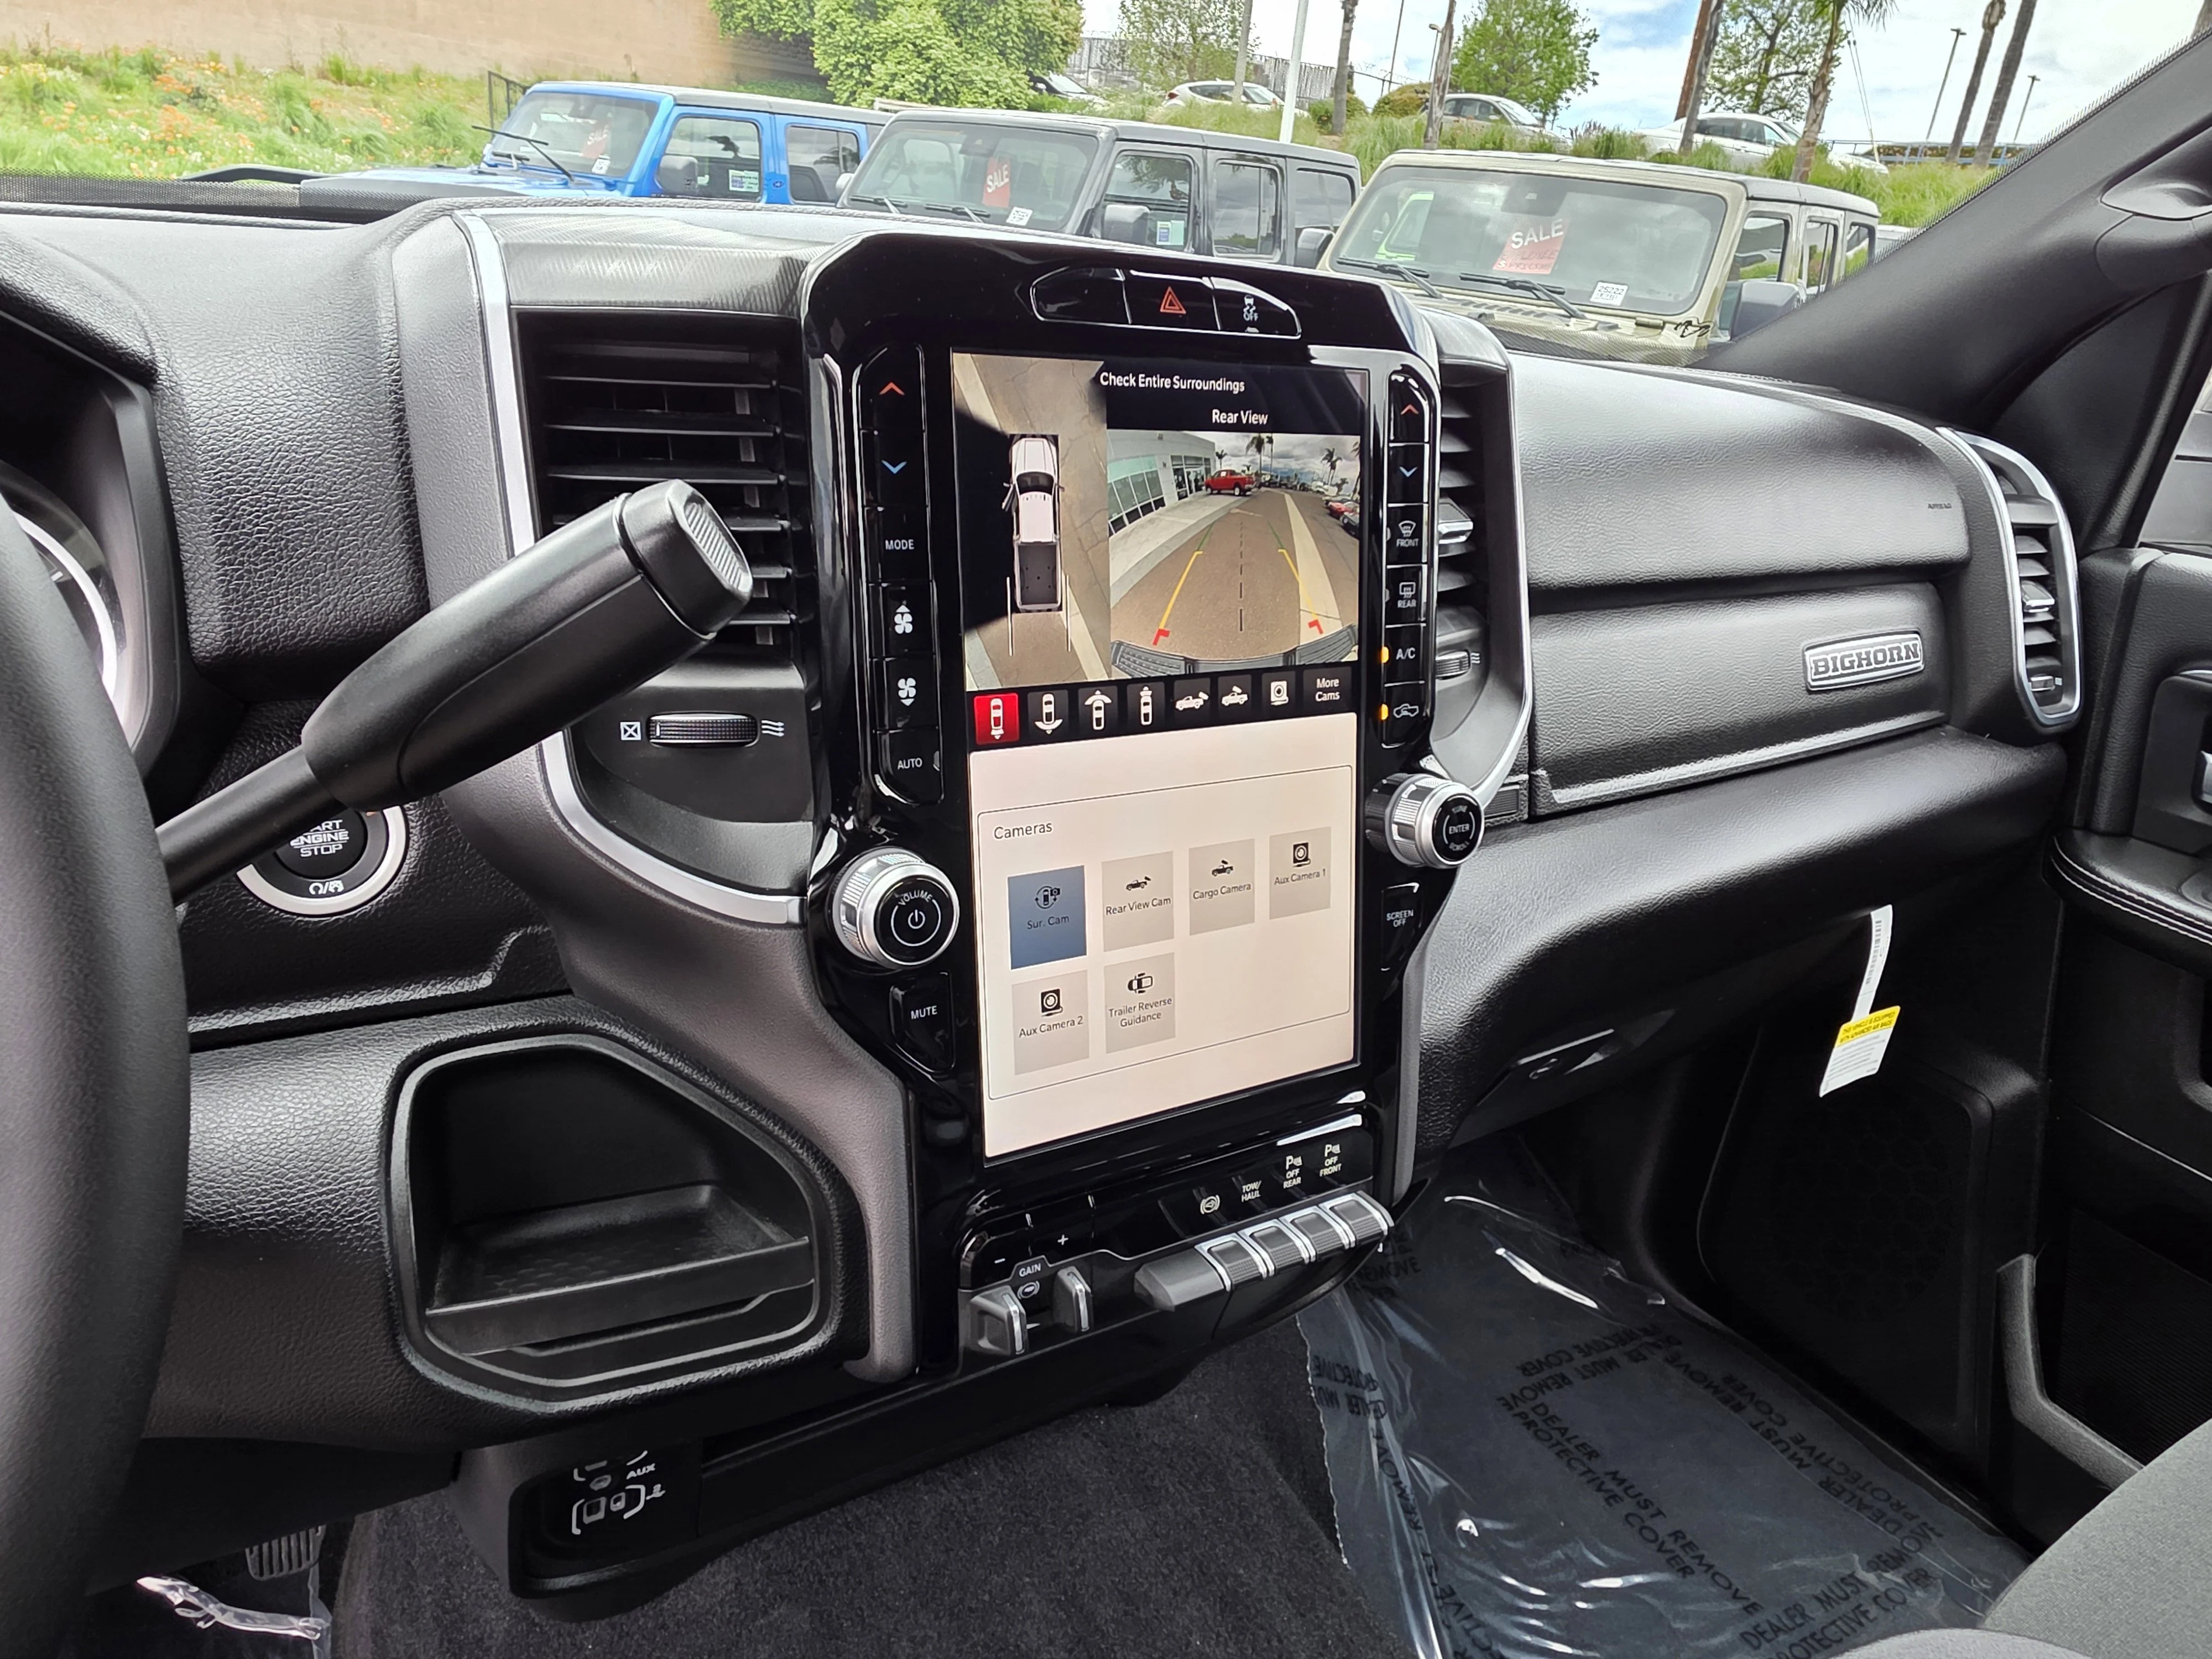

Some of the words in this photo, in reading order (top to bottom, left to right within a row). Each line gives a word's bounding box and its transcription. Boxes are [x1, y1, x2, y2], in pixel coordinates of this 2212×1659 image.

[987, 164, 1009, 193] SALE
[1511, 218, 1564, 249] SALE
[1243, 312, 1259, 321] OFF
[1099, 372, 1136, 387] Check
[1138, 373, 1171, 389] Entire
[1173, 375, 1245, 394] Surroundings
[1212, 409, 1239, 424] Rear
[1240, 410, 1269, 425] View
[885, 539, 915, 550] MODE
[1396, 538, 1419, 547] FRONT
[1397, 599, 1417, 608] REAR
[1396, 648, 1416, 660] A/C
[1811, 641, 1921, 679] BIGHORN
[1316, 677, 1339, 688] More
[1315, 691, 1340, 702] Cams
[897, 757, 923, 770] AUTO
[994, 822, 1052, 839] Cameras
[1449, 823, 1470, 834] ENTER
[290, 831, 349, 847] ENGINE
[300, 843, 343, 858] STOP
[1274, 875, 1290, 885] Aux
[1291, 870, 1320, 883] Camera
[1322, 868, 1326, 877] 1
[898, 889, 933, 906] VOLUME
[1193, 889, 1218, 900] Cargo
[1220, 883, 1251, 895] Camera
[1105, 904, 1127, 916] Rear
[1128, 900, 1150, 911] View
[1151, 896, 1171, 907] Cam
[1026, 919, 1046, 930] Sur.
[1047, 915, 1070, 926] Cam
[1386, 910, 1414, 921] SCREEN
[1393, 918, 1407, 927] OFF
[910, 1005, 938, 1020] MUTE
[1108, 1005, 1137, 1018] Trailer
[1138, 997, 1172, 1011] Reverse
[1019, 1027, 1037, 1038] Aux
[1039, 1019, 1076, 1034] Camera
[1077, 1015, 1084, 1025] 2
[1120, 1011, 1162, 1028] Guidance
[1319, 1163, 1342, 1177] FRONT
[1324, 1156, 1338, 1167] OFF
[1286, 1168, 1300, 1179] OFF
[1284, 1177, 1302, 1188] REAR
[1241, 1190, 1261, 1202] HAUL
[1019, 1263, 1041, 1277] GAIN
[1515, 1349, 1574, 1378] COVER
[1665, 1350, 1747, 1413] REMOVE
[1495, 1371, 1574, 1411] REMOVE
[1723, 1374, 1788, 1427] COVER
[1749, 1421, 1813, 1470] MUST
[1790, 1432, 1920, 1521] PROTECTIVE
[1512, 1411, 1625, 1509] PROTECTIVE
[1624, 1512, 1696, 1580] COVER
[1530, 1401, 1603, 1462] DEALER
[1605, 1469, 1668, 1522] MUST
[1667, 1528, 1764, 1616] REMOVE
[1818, 1476, 1903, 1535] DEALER
[1738, 1603, 1816, 1651] DEALER
[1813, 1571, 1869, 1612] MUST
[1767, 1604, 1879, 1659] OTECTIVE
[1871, 1567, 1937, 1614] COVER
